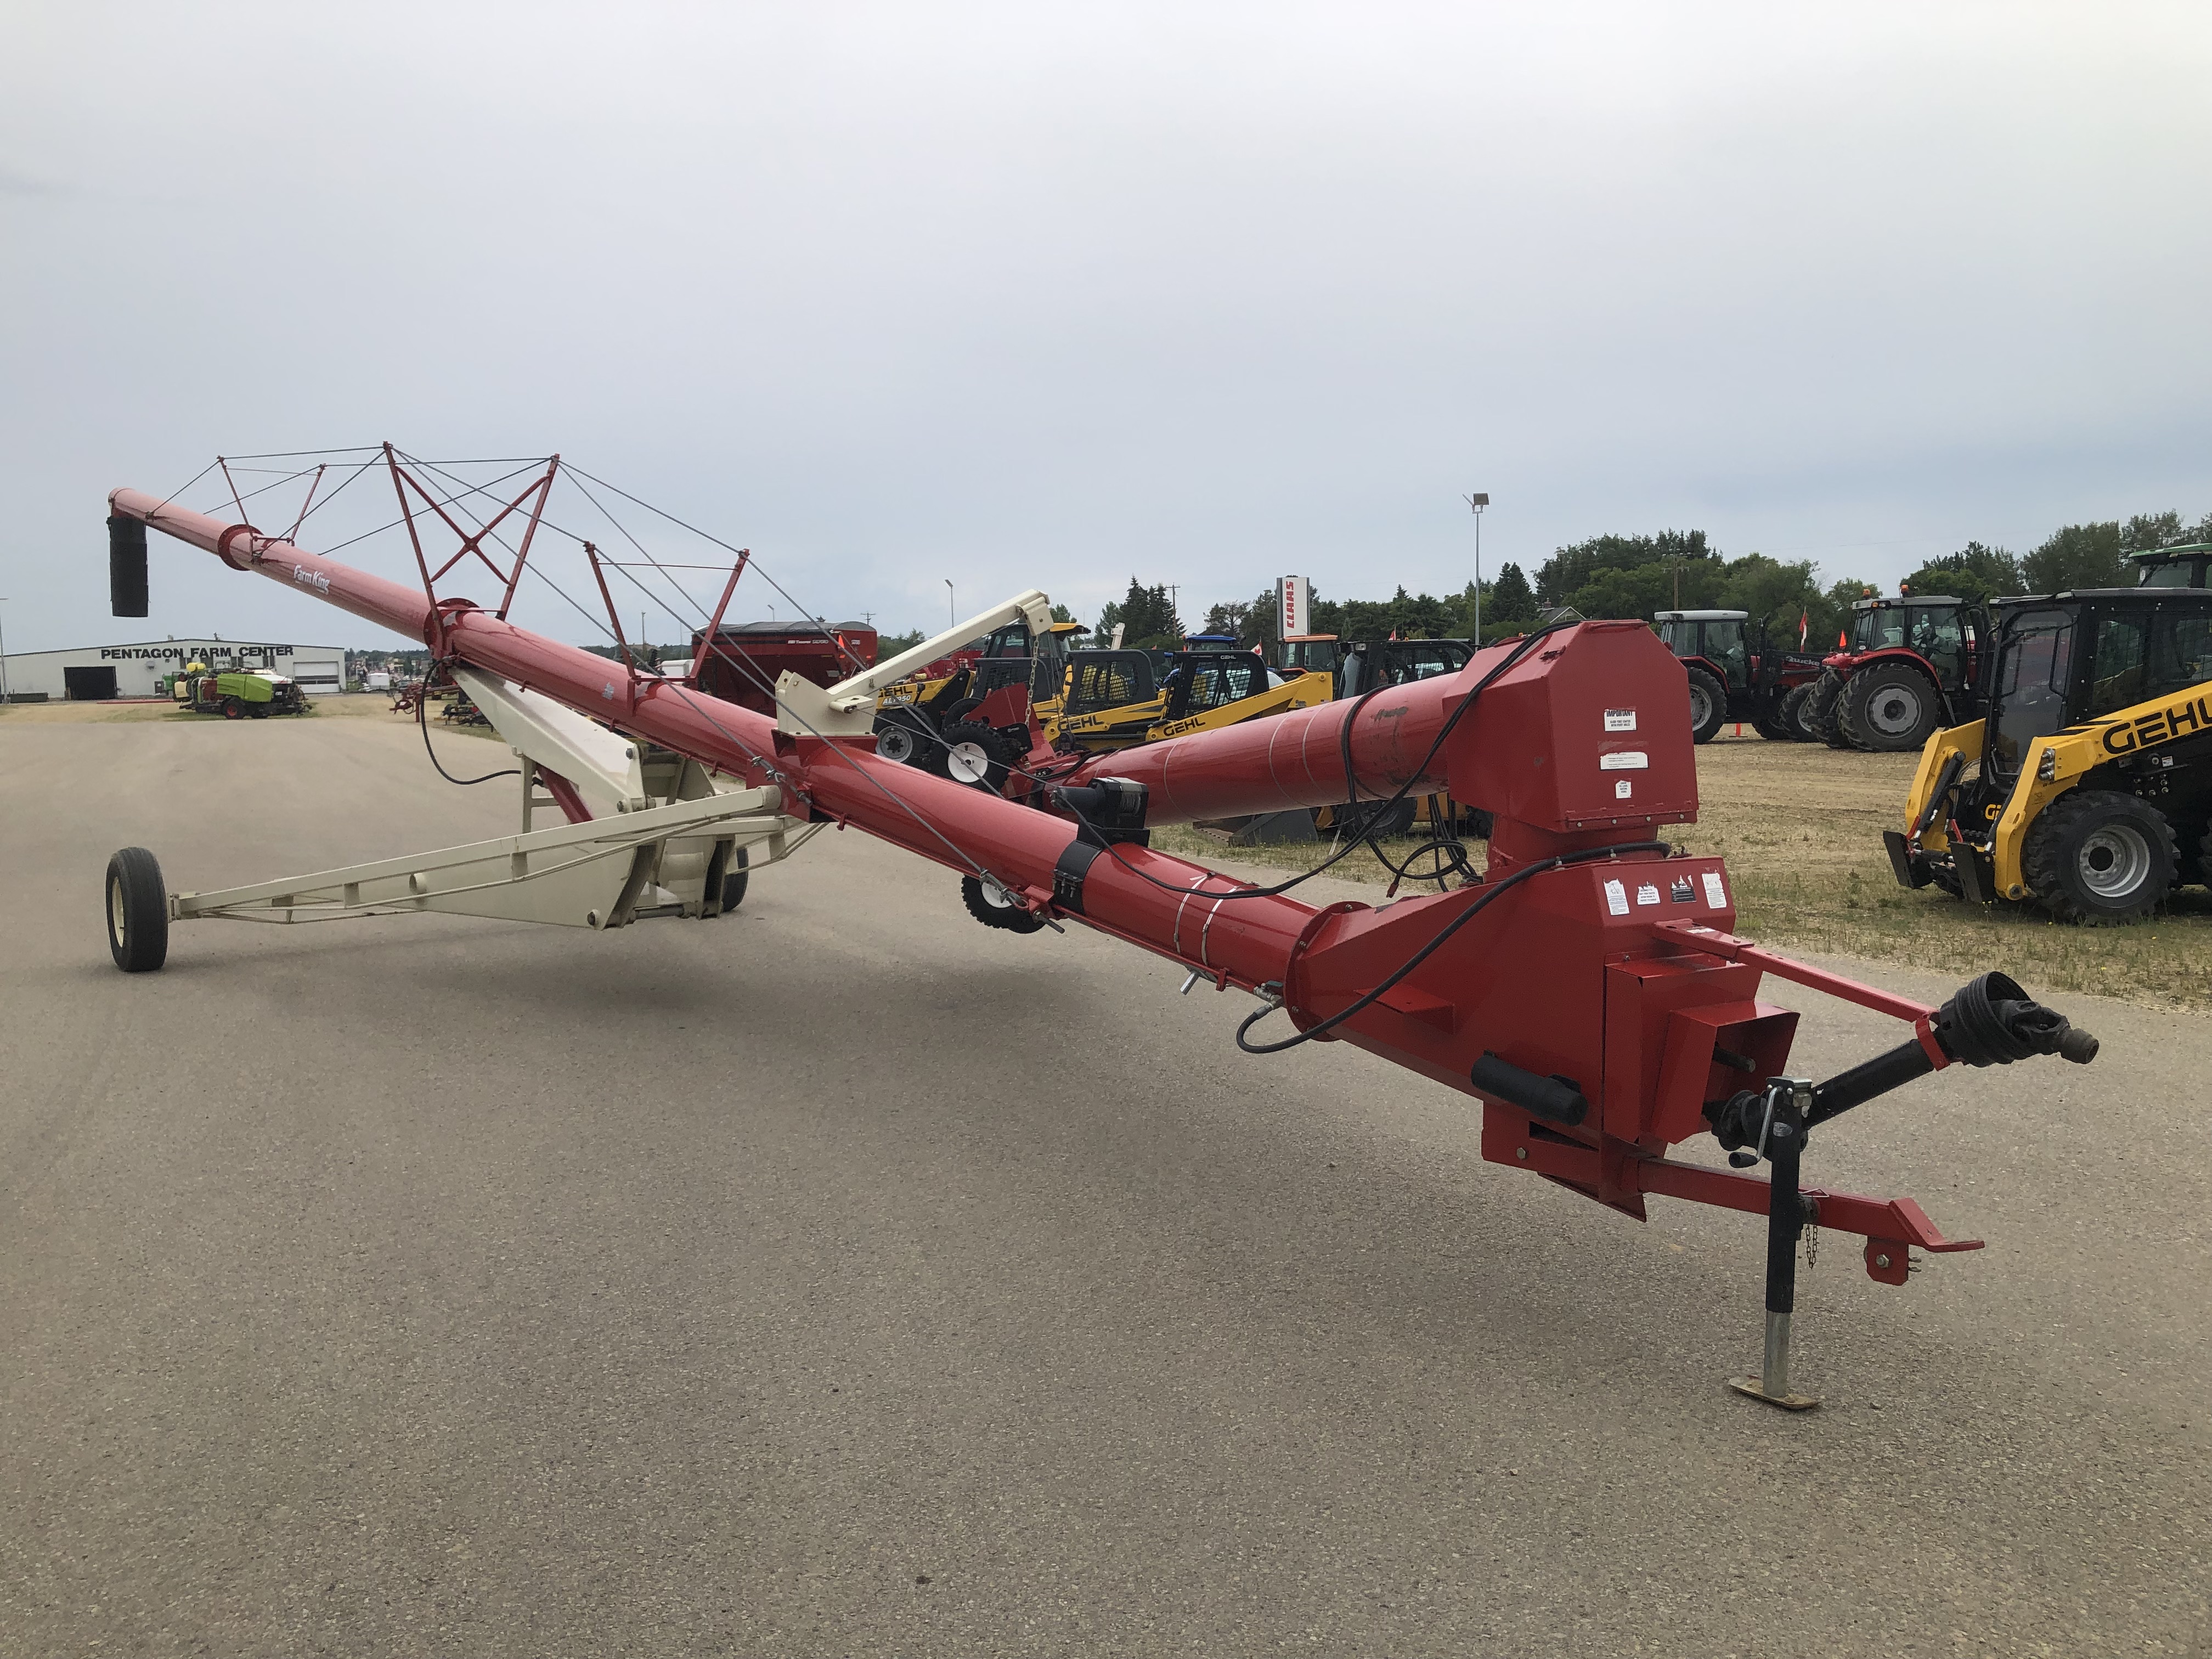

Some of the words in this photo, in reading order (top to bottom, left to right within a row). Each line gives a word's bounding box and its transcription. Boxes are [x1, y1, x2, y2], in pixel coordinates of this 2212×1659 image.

[294, 565, 312, 583] Farm
[312, 571, 330, 595] King
[1286, 581, 1294, 629] CLAAS
[101, 648, 183, 659] PENTAGON
[190, 647, 231, 657] FARM
[239, 646, 294, 657] CENTER
[1057, 715, 1104, 731] GEHL
[1163, 717, 1206, 736] GEHL
[2102, 697, 2212, 754] GEHL
